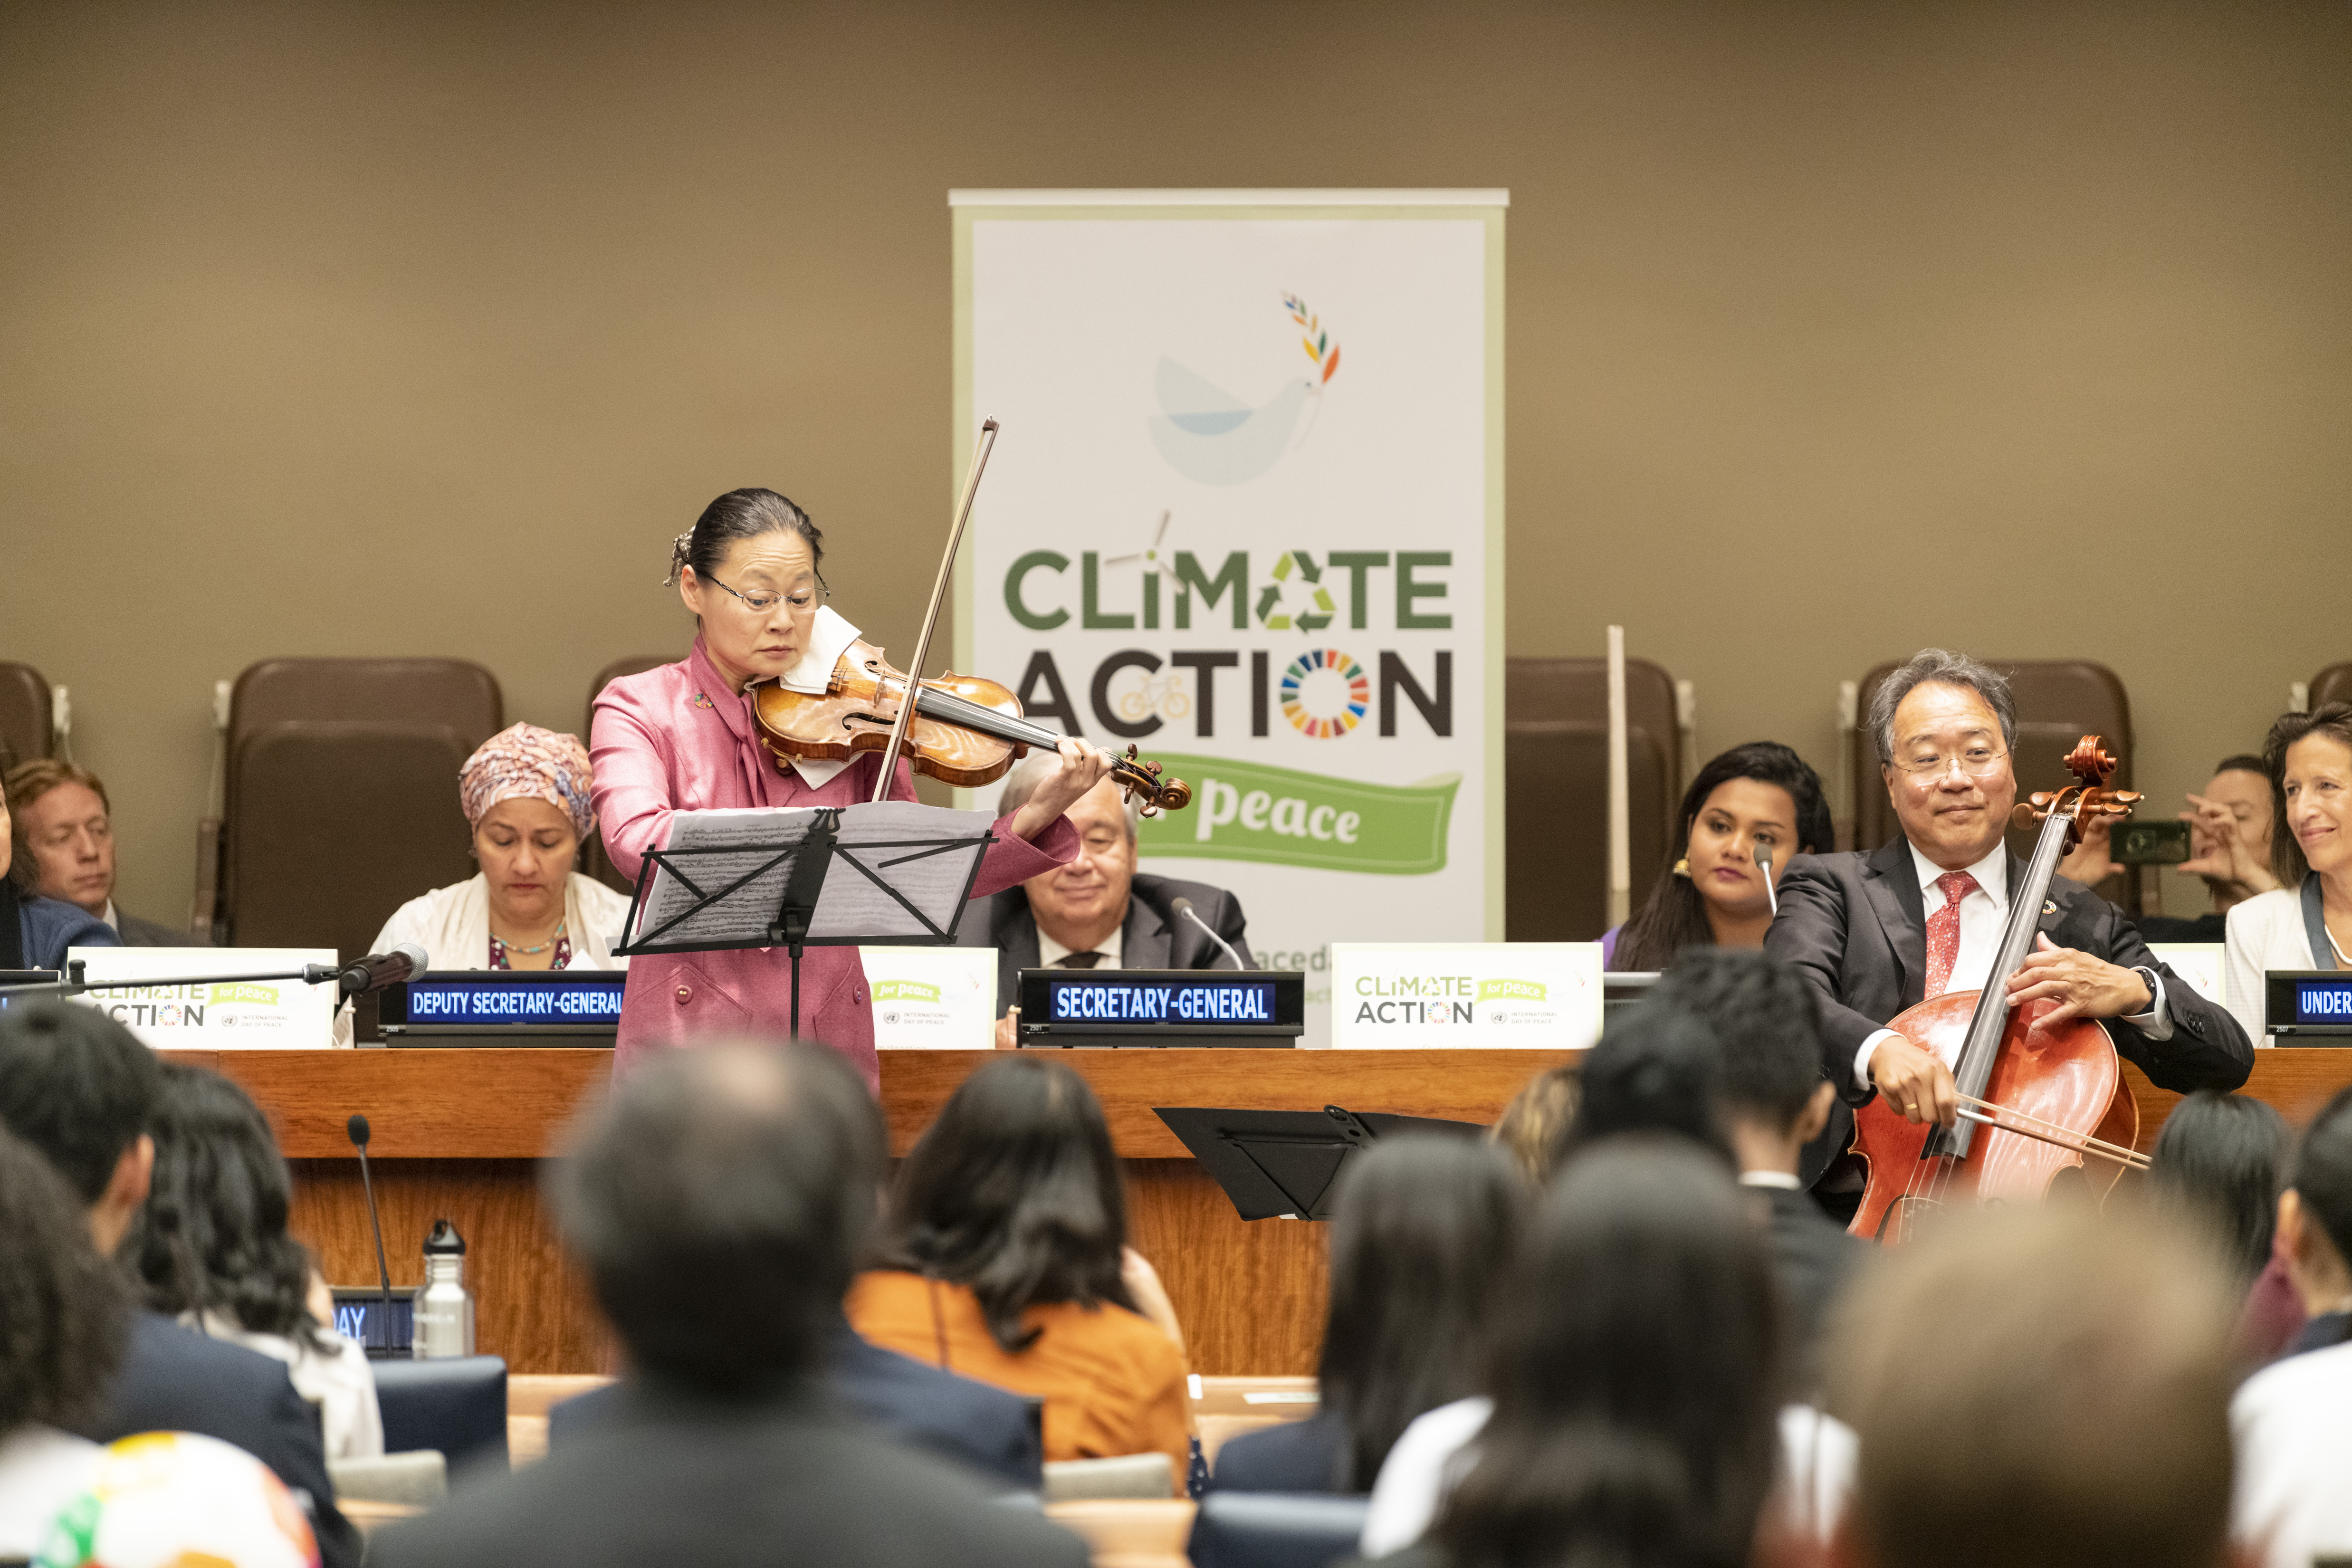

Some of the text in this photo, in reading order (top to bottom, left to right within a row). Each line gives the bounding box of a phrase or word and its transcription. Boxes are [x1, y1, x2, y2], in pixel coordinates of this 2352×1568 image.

[1021, 648, 1453, 739] ACTION
[1195, 777, 1361, 844] peace
[219, 985, 272, 1001] for peace
[879, 983, 934, 998] for peace
[1486, 982, 1540, 997] for peace
[413, 992, 621, 1014] DEPUTY SECRETARY-GENERAL
[1057, 987, 1268, 1019] SECRETARY-GENERAL
[1354, 1001, 1472, 1024] ACTION
[386, 1024, 399, 1033] 2505
[331, 1307, 365, 1340] AY
